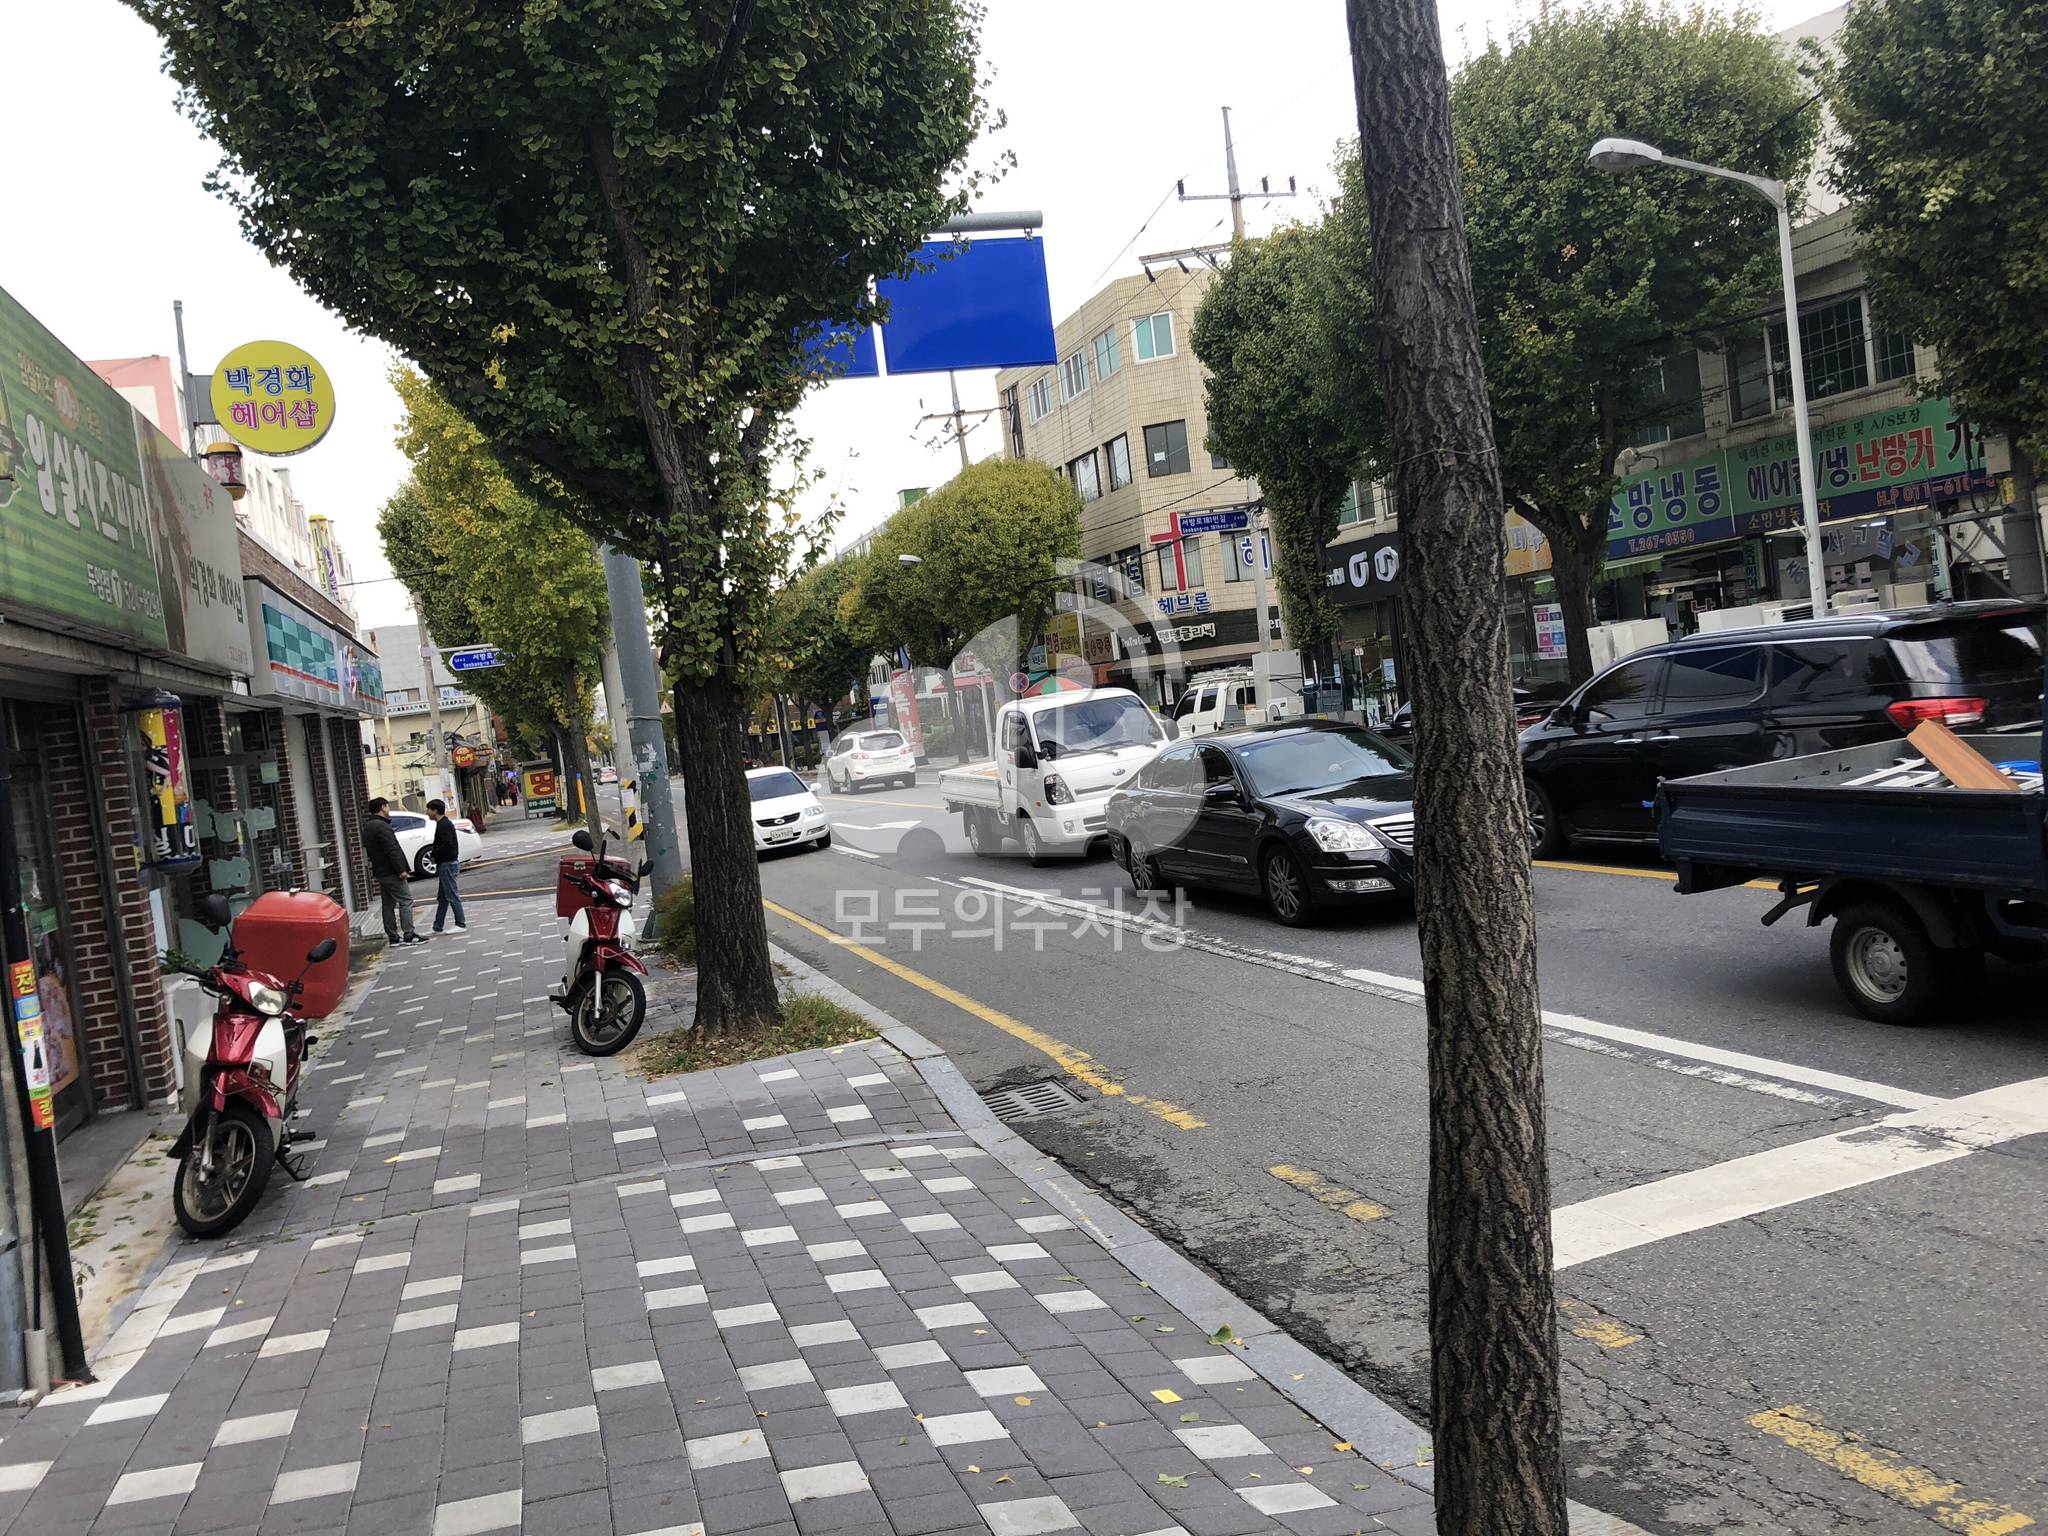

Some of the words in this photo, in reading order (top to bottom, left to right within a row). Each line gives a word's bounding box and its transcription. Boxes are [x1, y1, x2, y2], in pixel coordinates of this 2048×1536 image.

[224, 365, 315, 396] 박경화
[230, 398, 318, 430] 헤어샵
[1871, 407, 1921, 431] A/S보장
[1181, 514, 1226, 527] 서방로181번길
[1157, 591, 1212, 617] 헤브론
